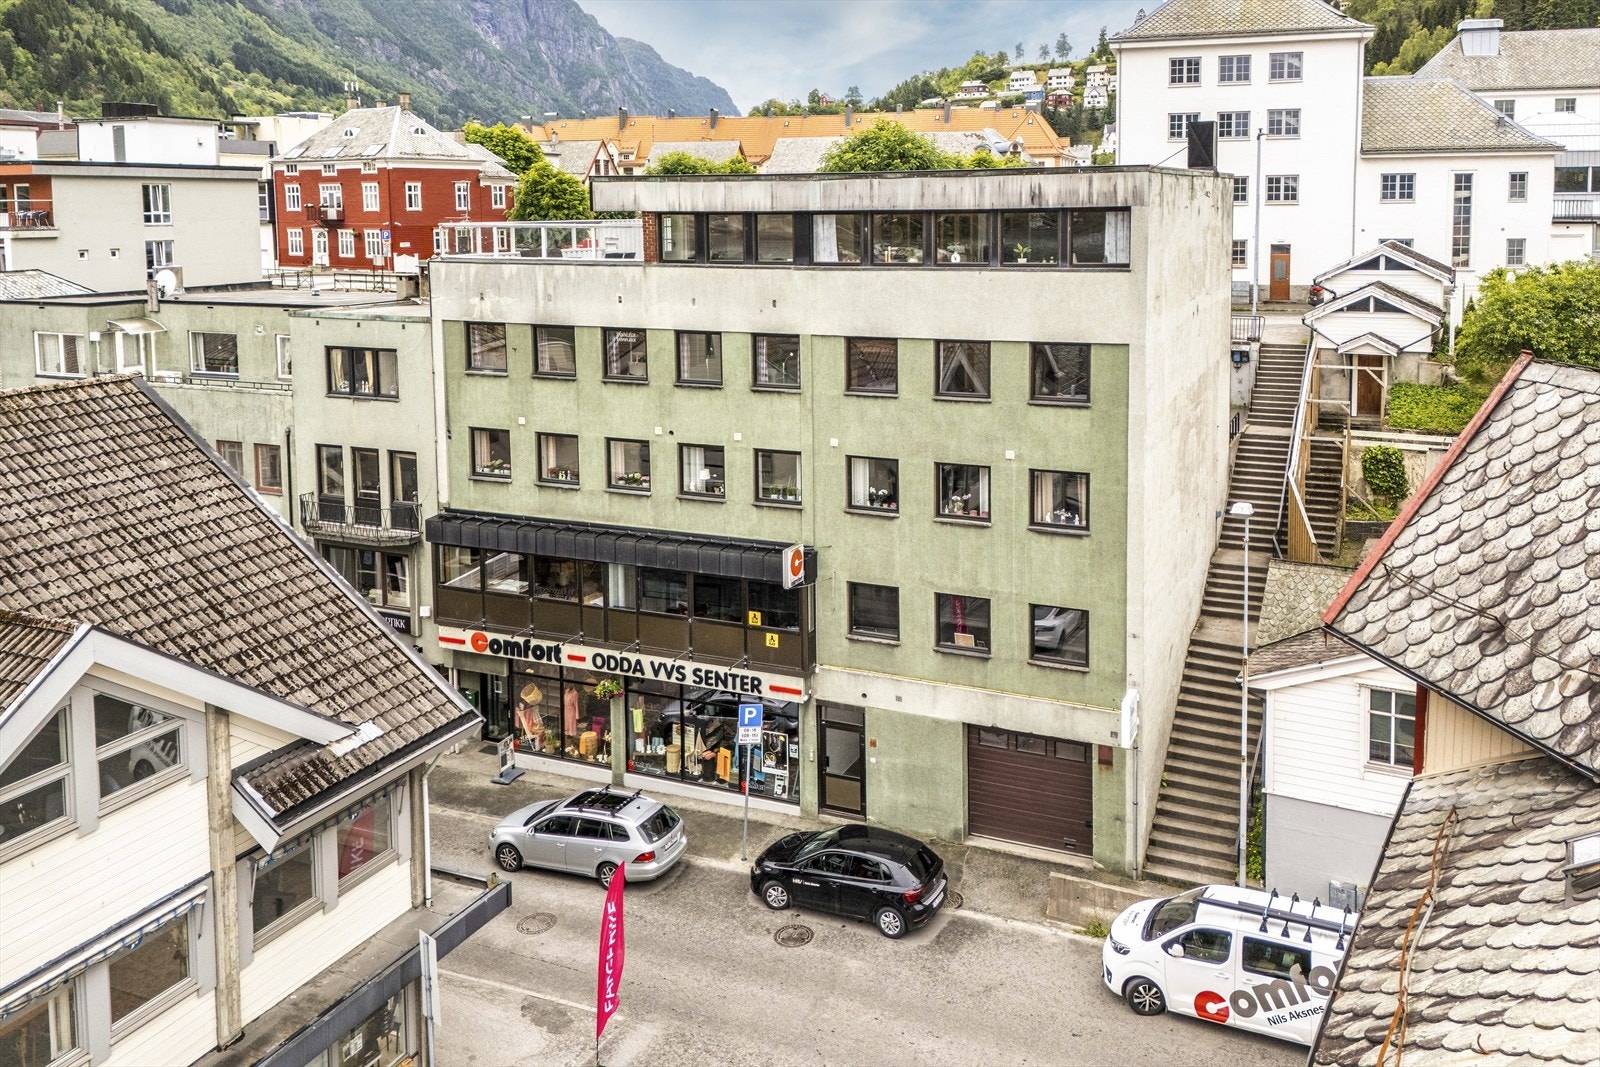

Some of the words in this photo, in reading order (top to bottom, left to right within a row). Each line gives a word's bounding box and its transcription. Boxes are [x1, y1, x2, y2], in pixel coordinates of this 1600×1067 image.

[471, 632, 562, 664] Comfort
[592, 653, 645, 676] ODDA
[650, 660, 687, 682] VVS
[692, 669, 763, 695] SENTER
[744, 707, 757, 725] P
[1194, 960, 1343, 1024] Comfo
[1267, 1013, 1288, 1027] Nils
[1289, 1004, 1326, 1022] Aksnes
